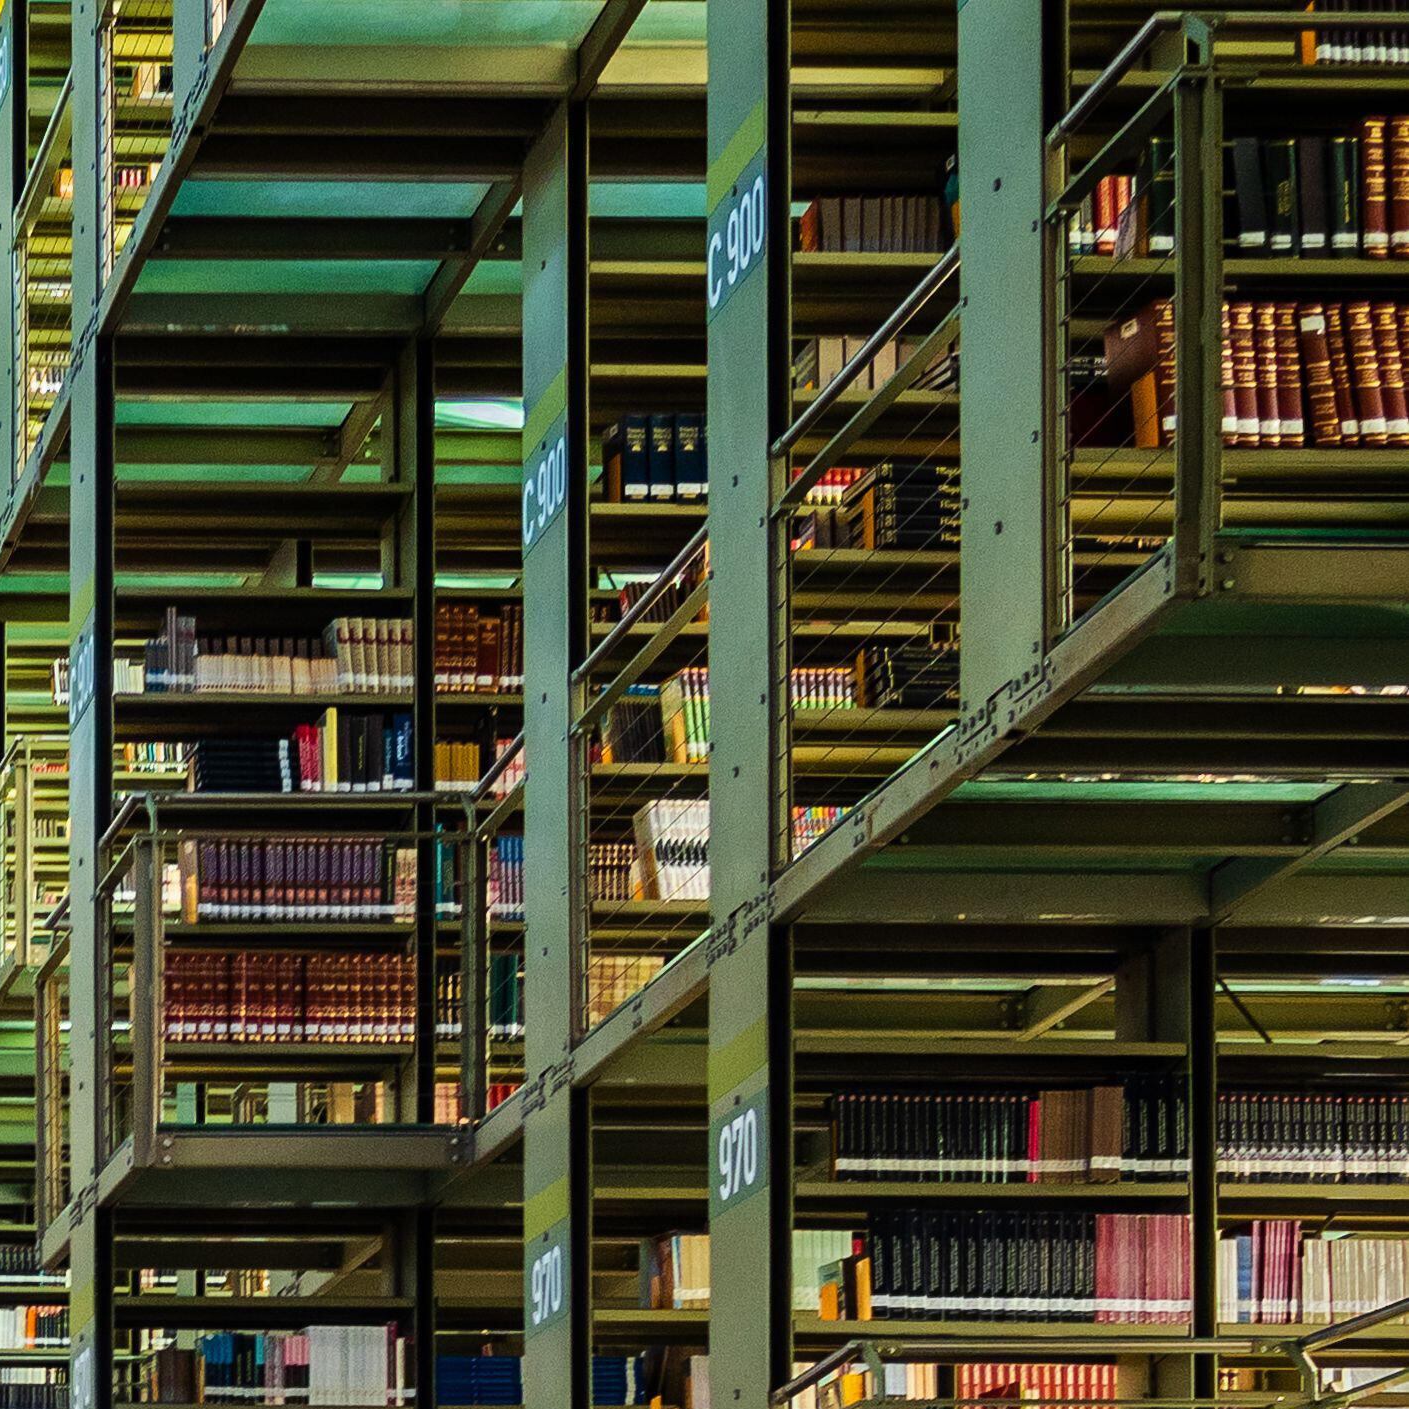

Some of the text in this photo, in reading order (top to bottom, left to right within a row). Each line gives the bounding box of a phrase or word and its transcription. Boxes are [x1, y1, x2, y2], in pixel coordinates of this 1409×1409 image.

[708, 175, 764, 309] C 900
[522, 437, 565, 545] C 900
[719, 1107, 758, 1201] 970
[532, 1244, 562, 1326] 970
